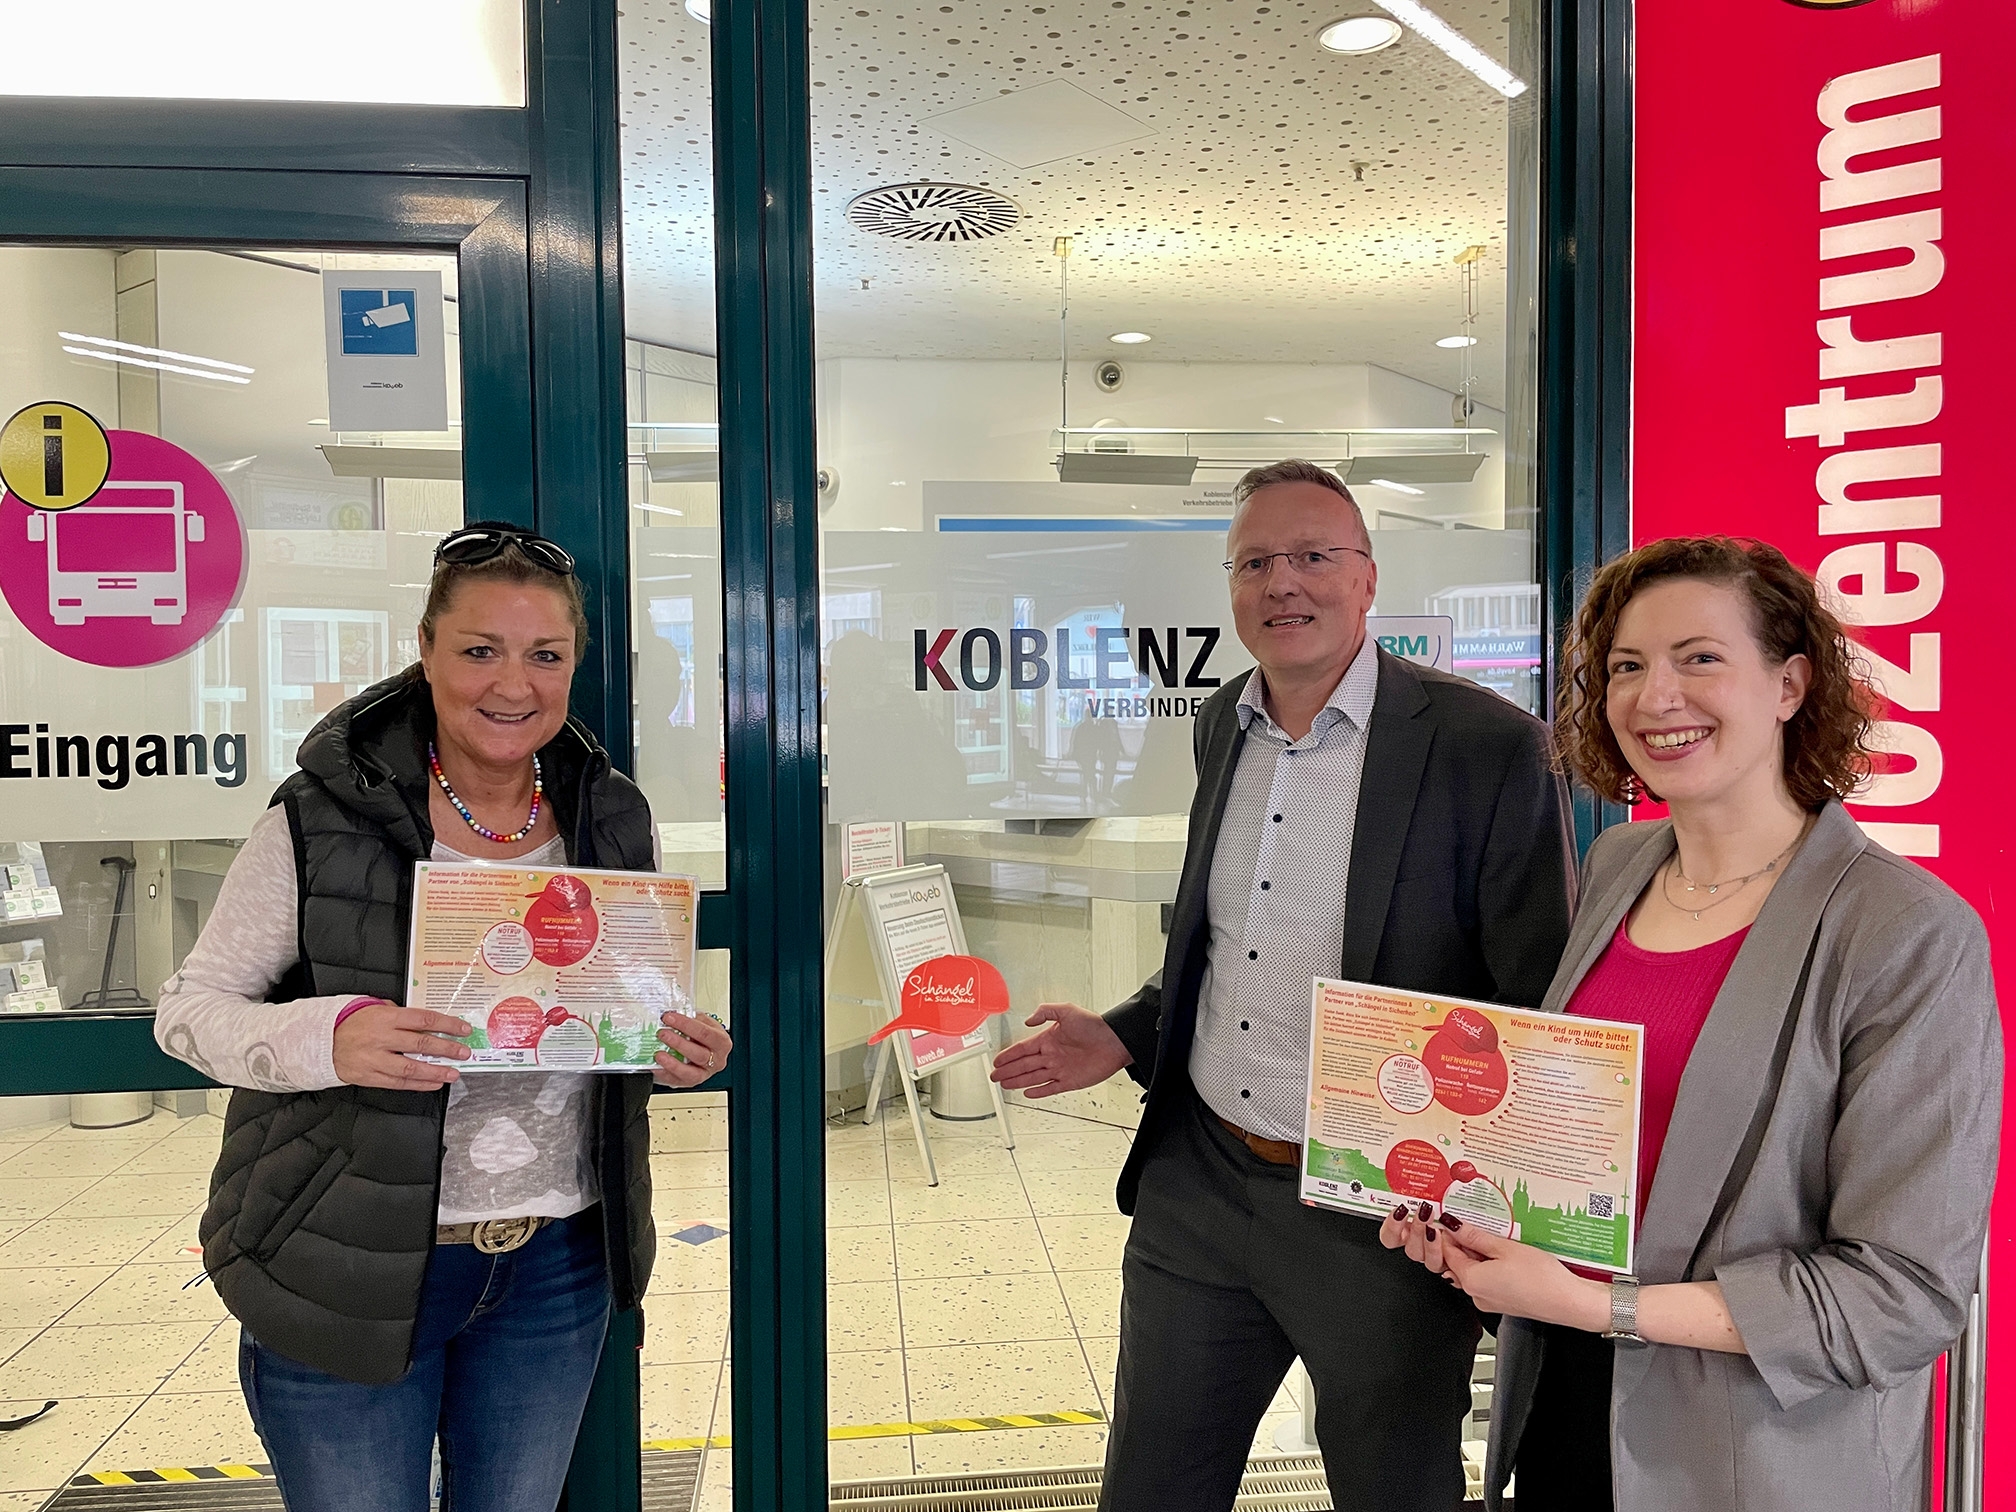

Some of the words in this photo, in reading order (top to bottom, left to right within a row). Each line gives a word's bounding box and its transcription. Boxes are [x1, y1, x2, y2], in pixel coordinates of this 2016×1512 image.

[1785, 53, 1945, 857] ozentrum
[1378, 636, 1428, 656] RM
[913, 627, 1222, 692] KOBLENZ
[1087, 697, 1209, 717] VERBINDE
[0, 723, 248, 791] Eingang
[909, 975, 975, 1005] Schängel
[934, 995, 976, 1004] Sicherheit
[1324, 988, 1355, 998] Information
[1355, 992, 1363, 1000] für
[1373, 996, 1408, 1007] Partnerinnen
[1324, 996, 1344, 1005] Partner
[1510, 1019, 1531, 1029] Wenn
[1533, 1023, 1546, 1031] ein
[1547, 1025, 1567, 1035] Kind
[1568, 1029, 1581, 1037] um
[1583, 1029, 1604, 1039] Hilfe
[1605, 1032, 1630, 1043] bittet
[1553, 1035, 1573, 1044] oder
[1574, 1037, 1603, 1049] Schutz
[1605, 1041, 1633, 1053] sucht:
[916, 1047, 946, 1066] koveb.de
[1394, 1060, 1420, 1071] NOTRUF
[1440, 1054, 1490, 1070] RUFNUMMERN
[1445, 1063, 1460, 1071] Notruf
[1468, 1067, 1484, 1076] Gefahr
[1320, 1084, 1350, 1096] Allgemeine
